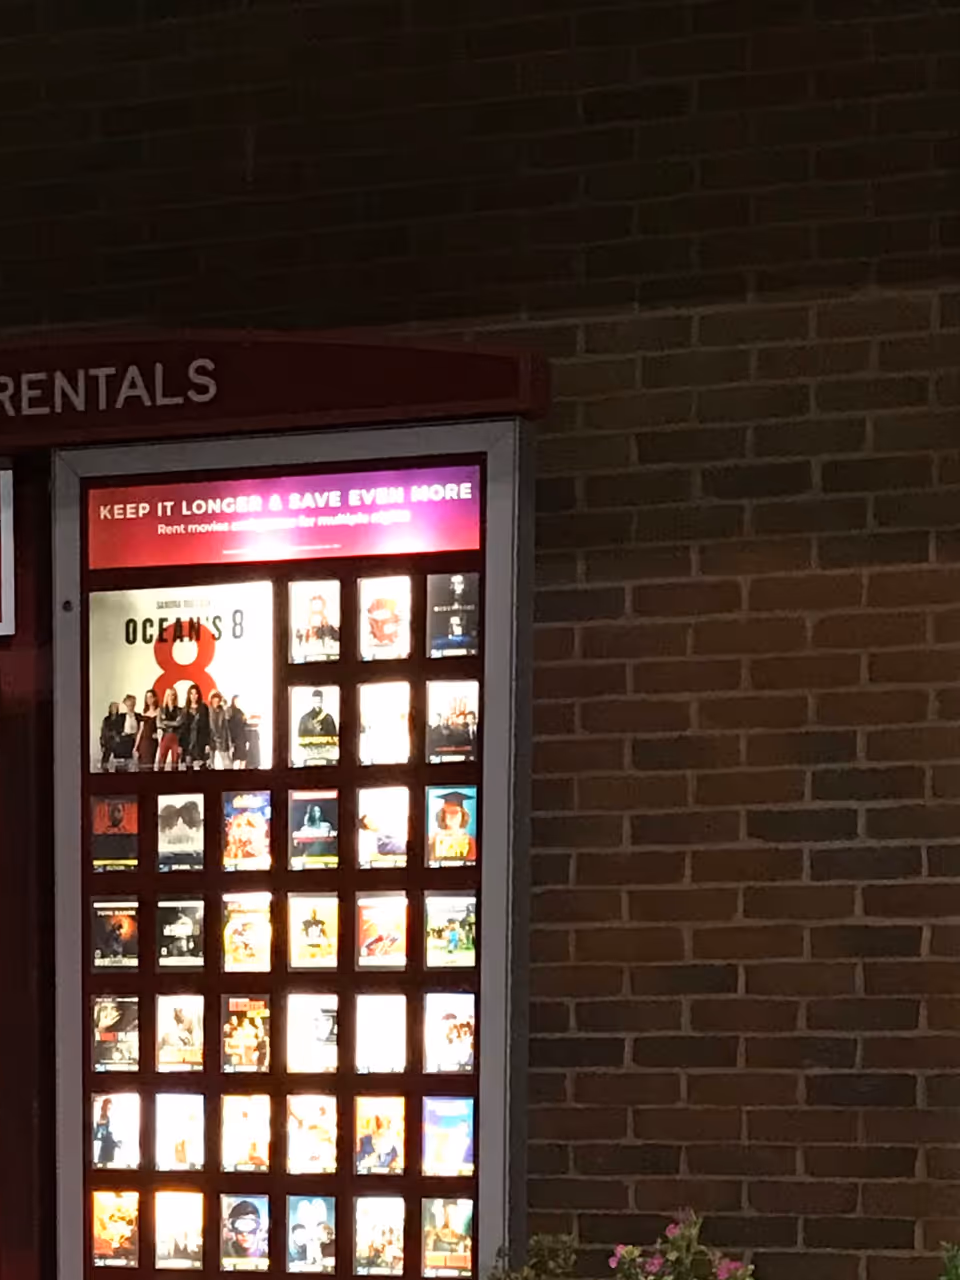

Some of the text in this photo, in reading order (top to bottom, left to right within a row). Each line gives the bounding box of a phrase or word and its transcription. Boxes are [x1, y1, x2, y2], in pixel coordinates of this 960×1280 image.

[100, 483, 472, 520] KEEP IT LONGER & SAVE EVEN MORE
[158, 524, 186, 535] Rent
[188, 521, 229, 534] movies
[125, 609, 244, 645] OCEAN'S 8
